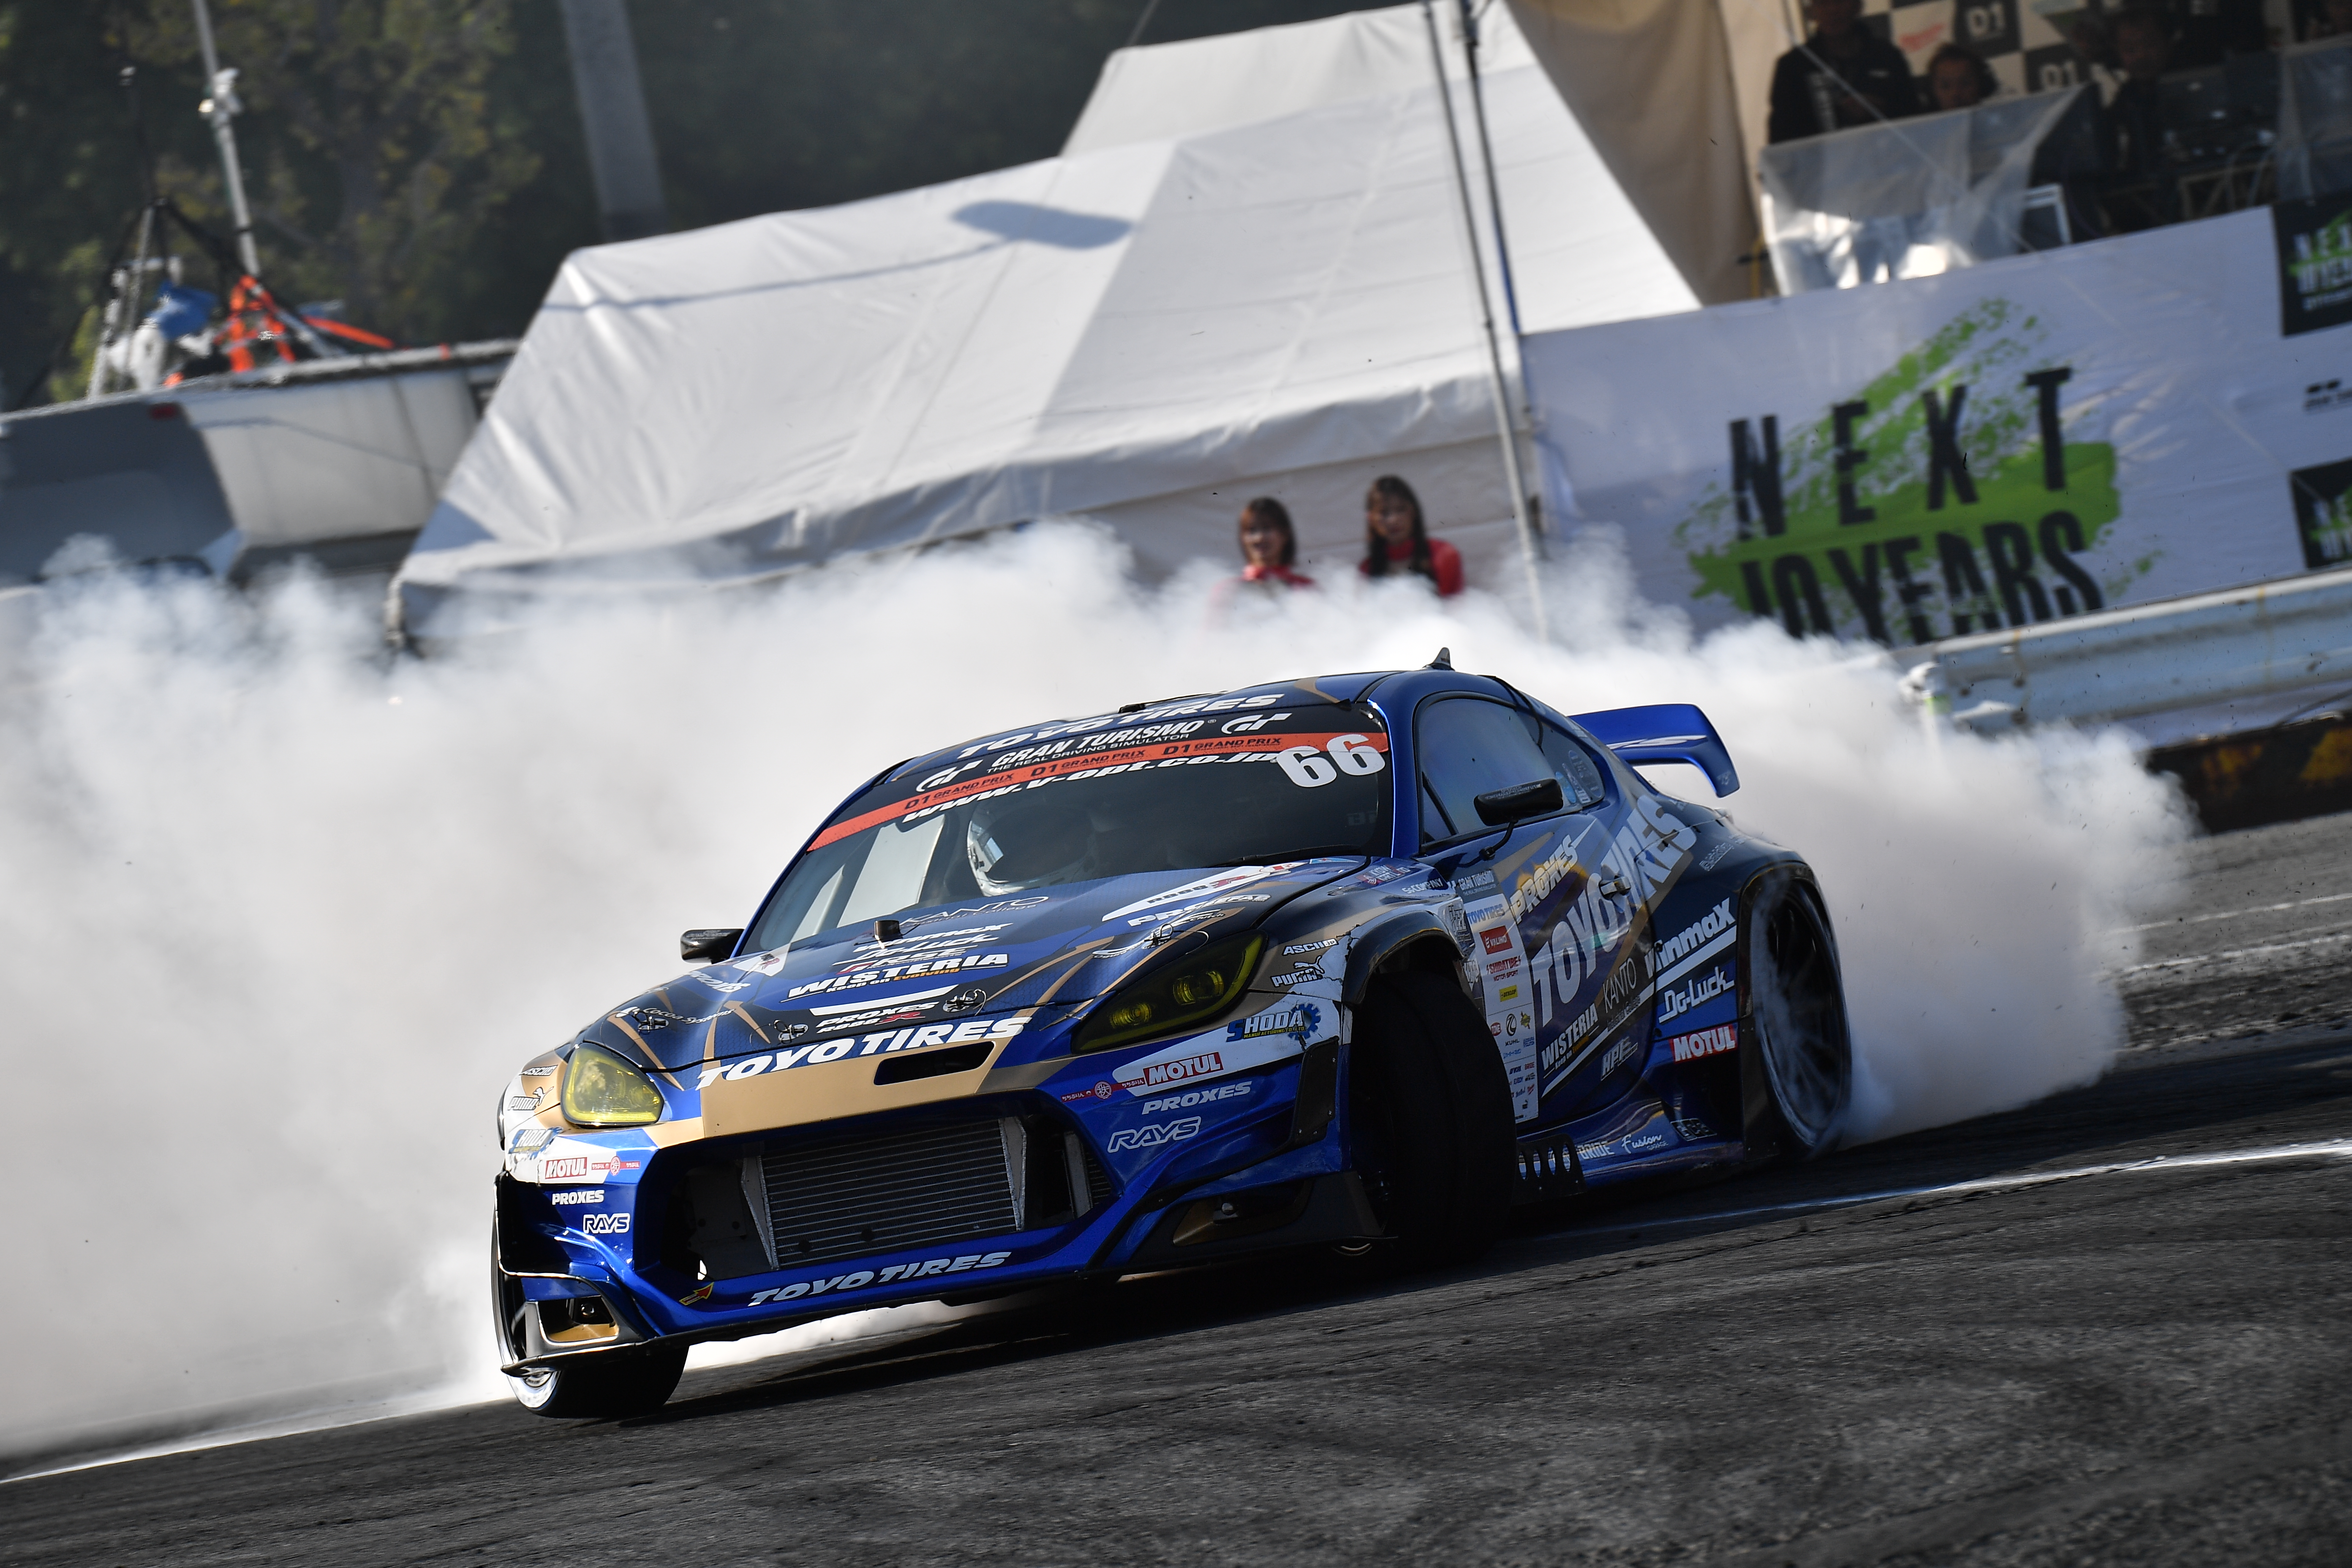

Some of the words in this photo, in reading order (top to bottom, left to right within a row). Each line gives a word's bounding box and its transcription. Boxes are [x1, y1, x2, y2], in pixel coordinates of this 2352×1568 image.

[1729, 366, 2072, 540] NEXT
[957, 717, 1113, 759] TOYO
[1117, 693, 1285, 724] TIRES
[991, 739, 1075, 767] GRAN
[1077, 720, 1205, 749] TURISMO
[986, 763, 1011, 773] THE
[1015, 757, 1048, 767] REAL
[1051, 745, 1106, 759] DRIVING
[1110, 734, 1190, 749] SIMULATOR
[1030, 764, 1058, 776] D1
[1062, 755, 1109, 768] GRAND
[1111, 750, 1146, 760] PRIX
[1163, 744, 1191, 755] D1
[1194, 739, 1244, 749] GRAND
[1277, 734, 1385, 787] 66
[904, 795, 931, 810] D1
[934, 782, 979, 798] GRAND
[981, 773, 1014, 786] PRIX
[899, 896, 1049, 926] KANTO
[1531, 873, 1618, 1027] TOYO
[1601, 794, 1697, 930] TIRES
[788, 954, 1008, 998] WISTERIA
[1271, 969, 1320, 987] PUMA
[1603, 958, 1636, 1013] KANTO
[816, 1002, 940, 1028] PROXES
[1226, 1010, 1304, 1042] SHODA
[1244, 1029, 1285, 1039] MANUFACTURING
[1542, 1003, 1598, 1070] WISTERIA
[1673, 1026, 1736, 1062] MOTUL
[695, 1038, 855, 1091] TOYO
[860, 1016, 1033, 1056] TIRES
[1148, 1054, 1222, 1084] MOTUL
[508, 1097, 539, 1111] PUMA
[1142, 1081, 1252, 1115] PROXES
[1107, 1116, 1201, 1153] RAYS
[1621, 1134, 1662, 1154] Fusion
[546, 1158, 586, 1178] MOTUL
[552, 1190, 604, 1205] PROXES
[583, 1213, 630, 1233] RAYS
[748, 1271, 874, 1306] TOYO
[879, 1252, 1012, 1283] TIRES
